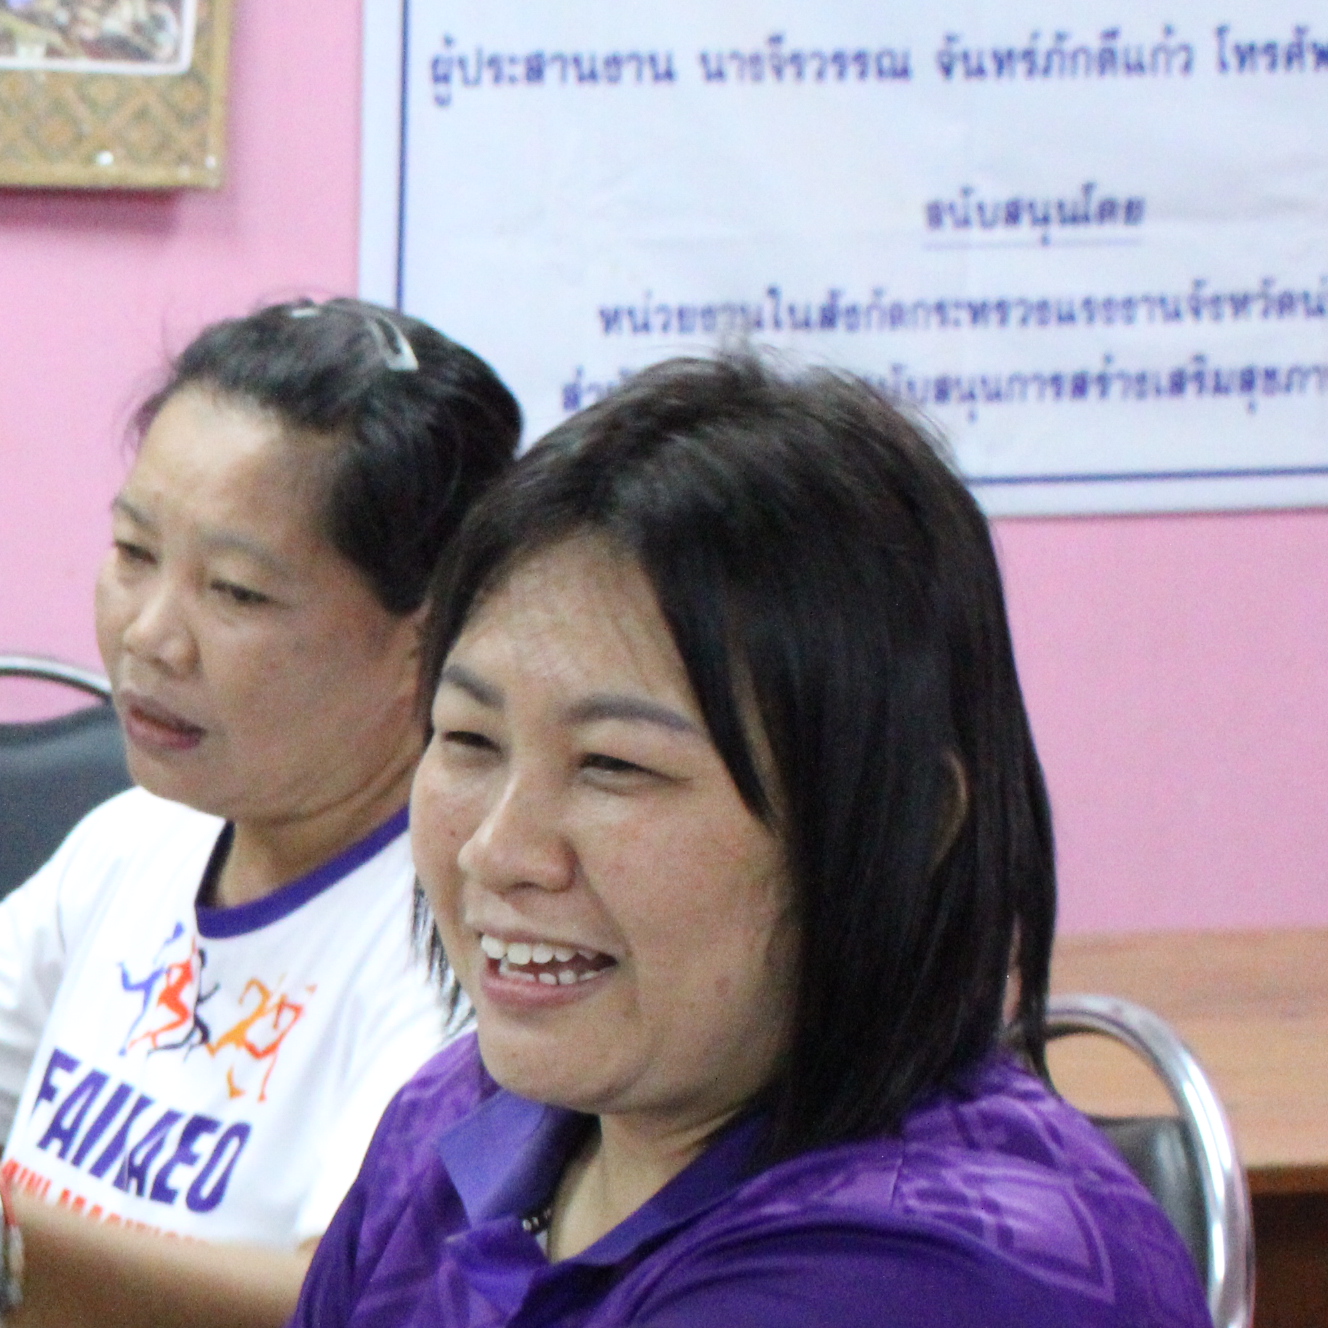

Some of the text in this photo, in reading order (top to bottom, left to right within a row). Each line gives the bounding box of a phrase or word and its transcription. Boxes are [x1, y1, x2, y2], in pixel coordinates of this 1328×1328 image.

[431, 32, 676, 106] ผู้ประสานงาน
[925, 180, 1145, 246] สนับสนุนโดย
